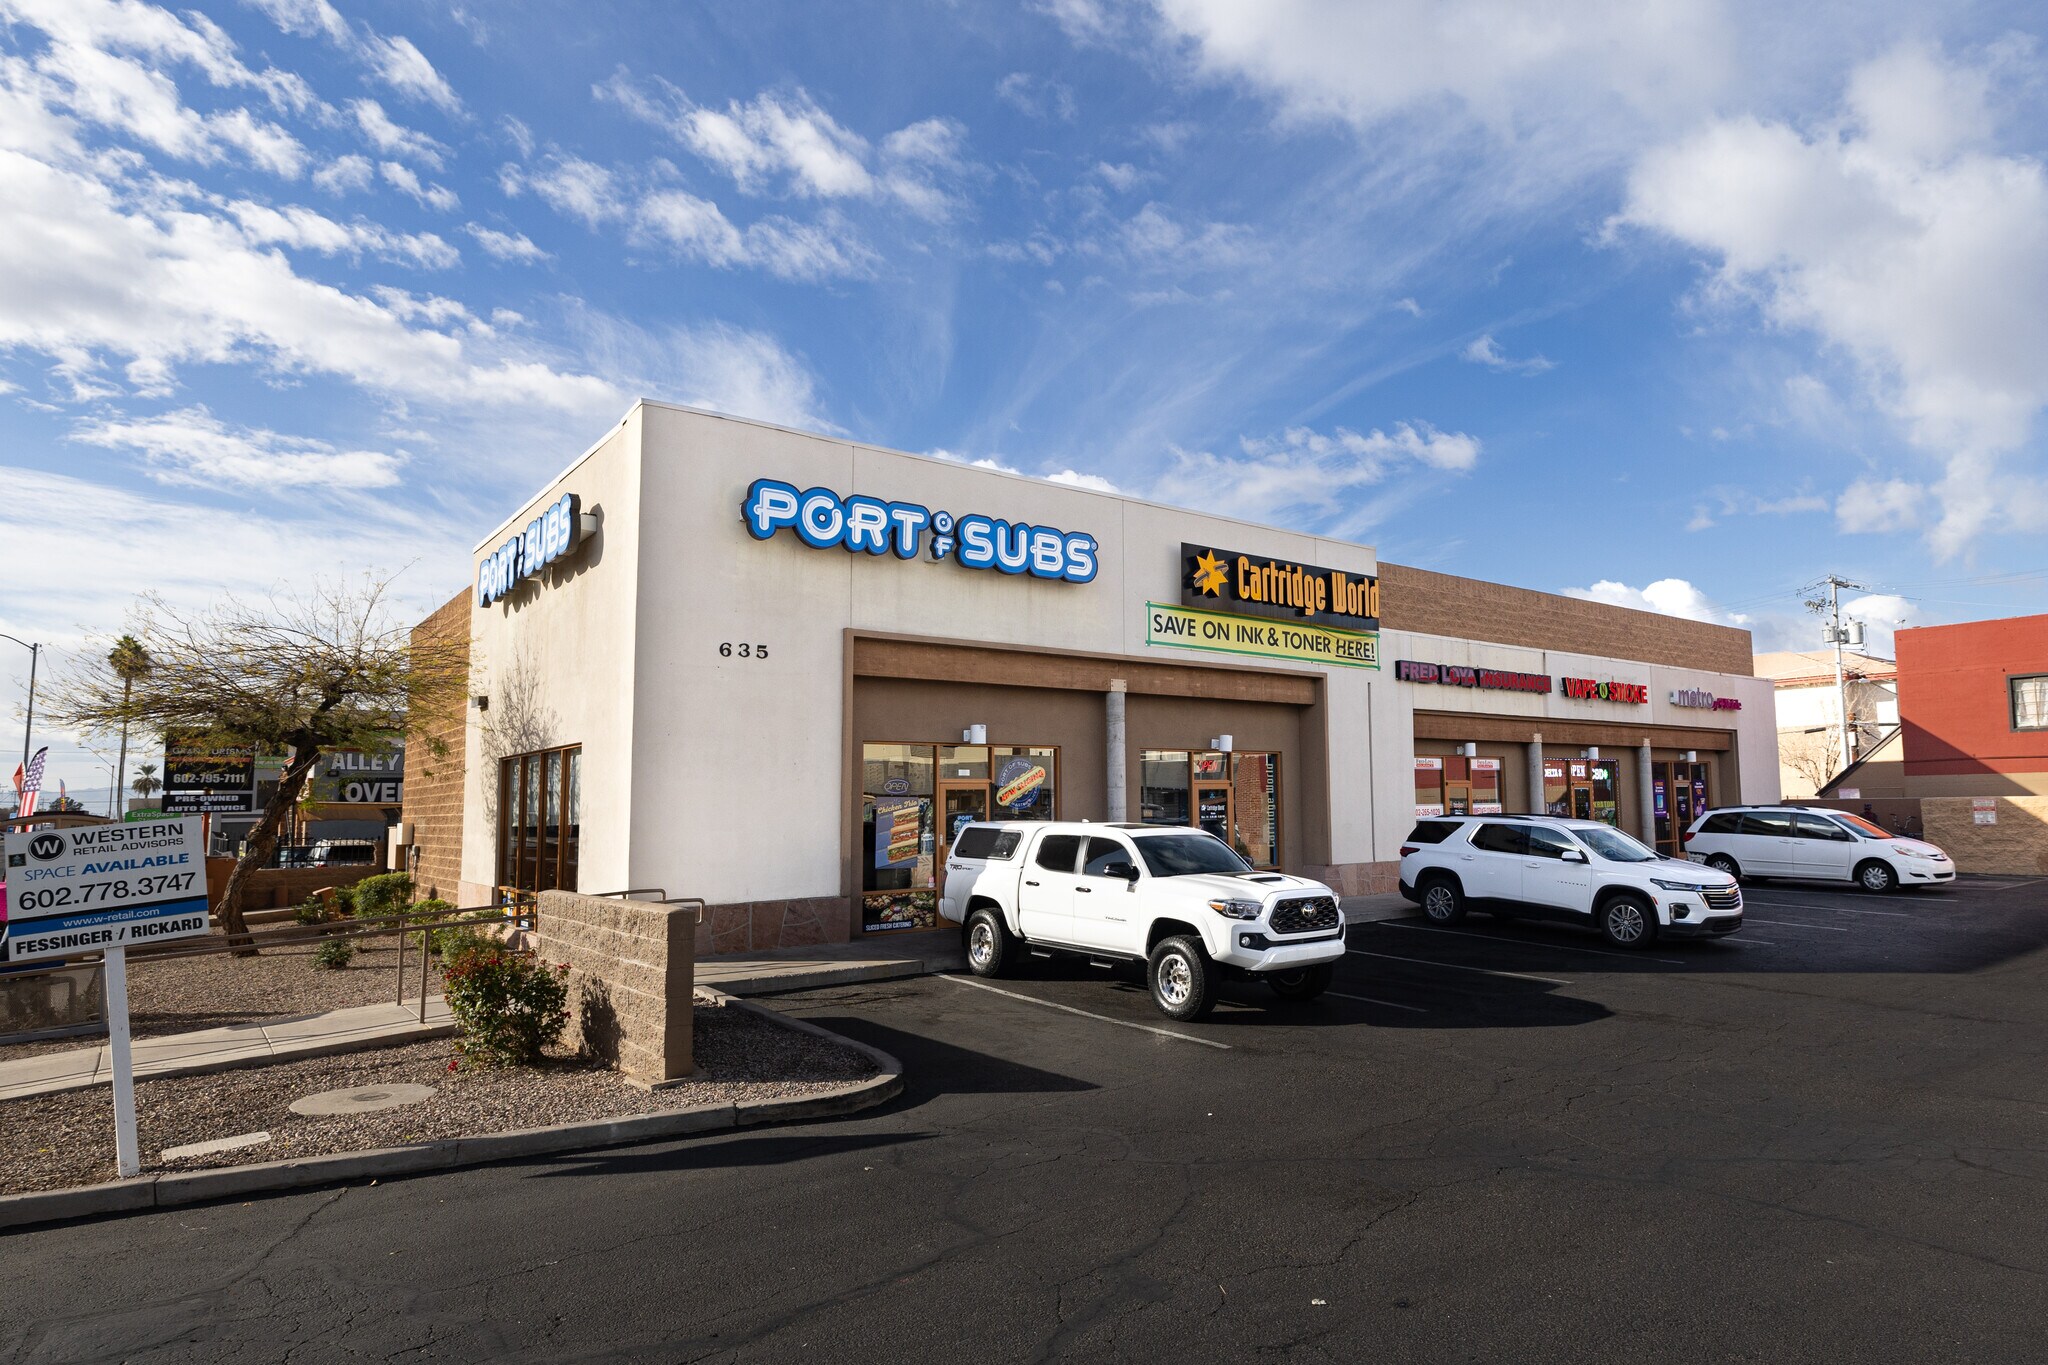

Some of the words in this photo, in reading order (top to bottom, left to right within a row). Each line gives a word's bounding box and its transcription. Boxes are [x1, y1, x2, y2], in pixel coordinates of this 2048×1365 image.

[752, 485, 926, 552] PORT
[933, 513, 954, 557] OF
[962, 520, 1094, 578] SUBS
[479, 541, 517, 607] PORT
[524, 500, 571, 571] SUBS
[1237, 555, 1326, 617] Cartridge
[1331, 572, 1379, 618] World
[1153, 613, 1196, 637] SAVE
[1202, 621, 1230, 641] ON
[1236, 625, 1264, 645] INK
[1267, 627, 1279, 647] &
[1282, 631, 1331, 653] TONER
[1335, 639, 1375, 660] HERE!
[719, 642, 769, 659] 635
[1400, 661, 1438, 681] FRED
[1441, 665, 1477, 685] LOYA
[1480, 669, 1550, 692] INSURANCE
[1566, 677, 1598, 699] VAPE
[1608, 682, 1648, 704] SMOKE
[1678, 687, 1713, 709] metro
[331, 753, 400, 770] ALLEY
[1197, 760, 1218, 771] OPEN
[173, 773, 245, 783] 602-795-7111
[885, 782, 909, 791] OPEN
[72, 823, 184, 845] WESTERN
[33, 839, 60, 855] W
[73, 844, 117, 856] RETAIL
[121, 838, 184, 851] ADVISORS
[24, 866, 76, 881] SPACE
[81, 853, 190, 875] AVAILABLE
[19, 872, 196, 910] 602.778.3747
[63, 907, 160, 927] www.w-retail.com
[16, 930, 113, 954] FESSINGER
[118, 928, 126, 940] /
[131, 917, 203, 938] RICKARD
